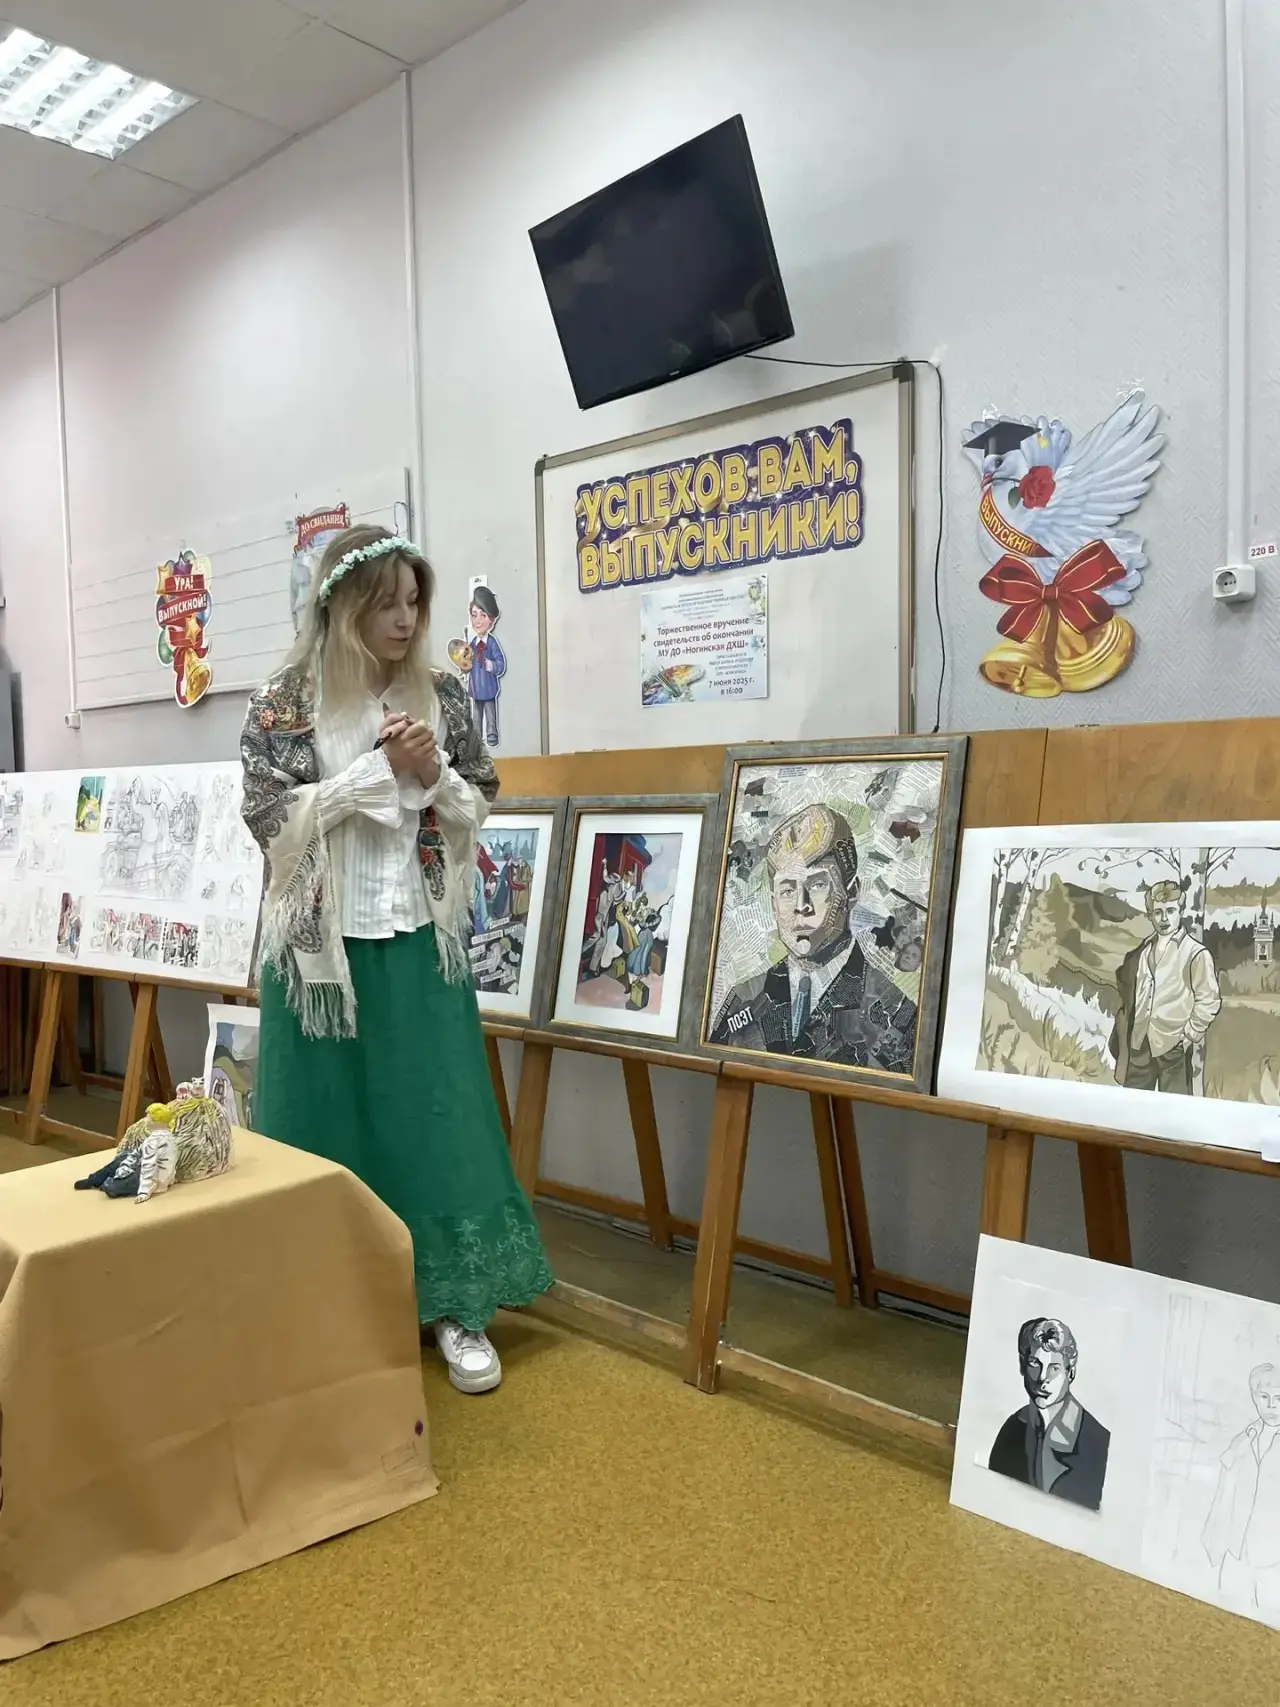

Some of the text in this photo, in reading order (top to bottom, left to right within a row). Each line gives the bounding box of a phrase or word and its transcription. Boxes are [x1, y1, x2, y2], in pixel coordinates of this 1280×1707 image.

[581, 427, 858, 533] УСПЕХОВ ВАМ,
[579, 489, 860, 588] ВЫПУСКНИКИ!
[1251, 547, 1266, 556] 220
[174, 575, 194, 591] УРА!
[158, 593, 207, 623] ВЫПУСКНОЙ!
[657, 622, 712, 636] Торжественное
[713, 617, 750, 629] вручение
[653, 629, 754, 647] свидетельств об окончании
[658, 649, 670, 657] МУ
[670, 647, 681, 658] ДО
[708, 680, 713, 688] 7
[732, 677, 748, 686] 2025
[726, 686, 743, 696] 16:00
[726, 1006, 754, 1034] ПОЭТ
